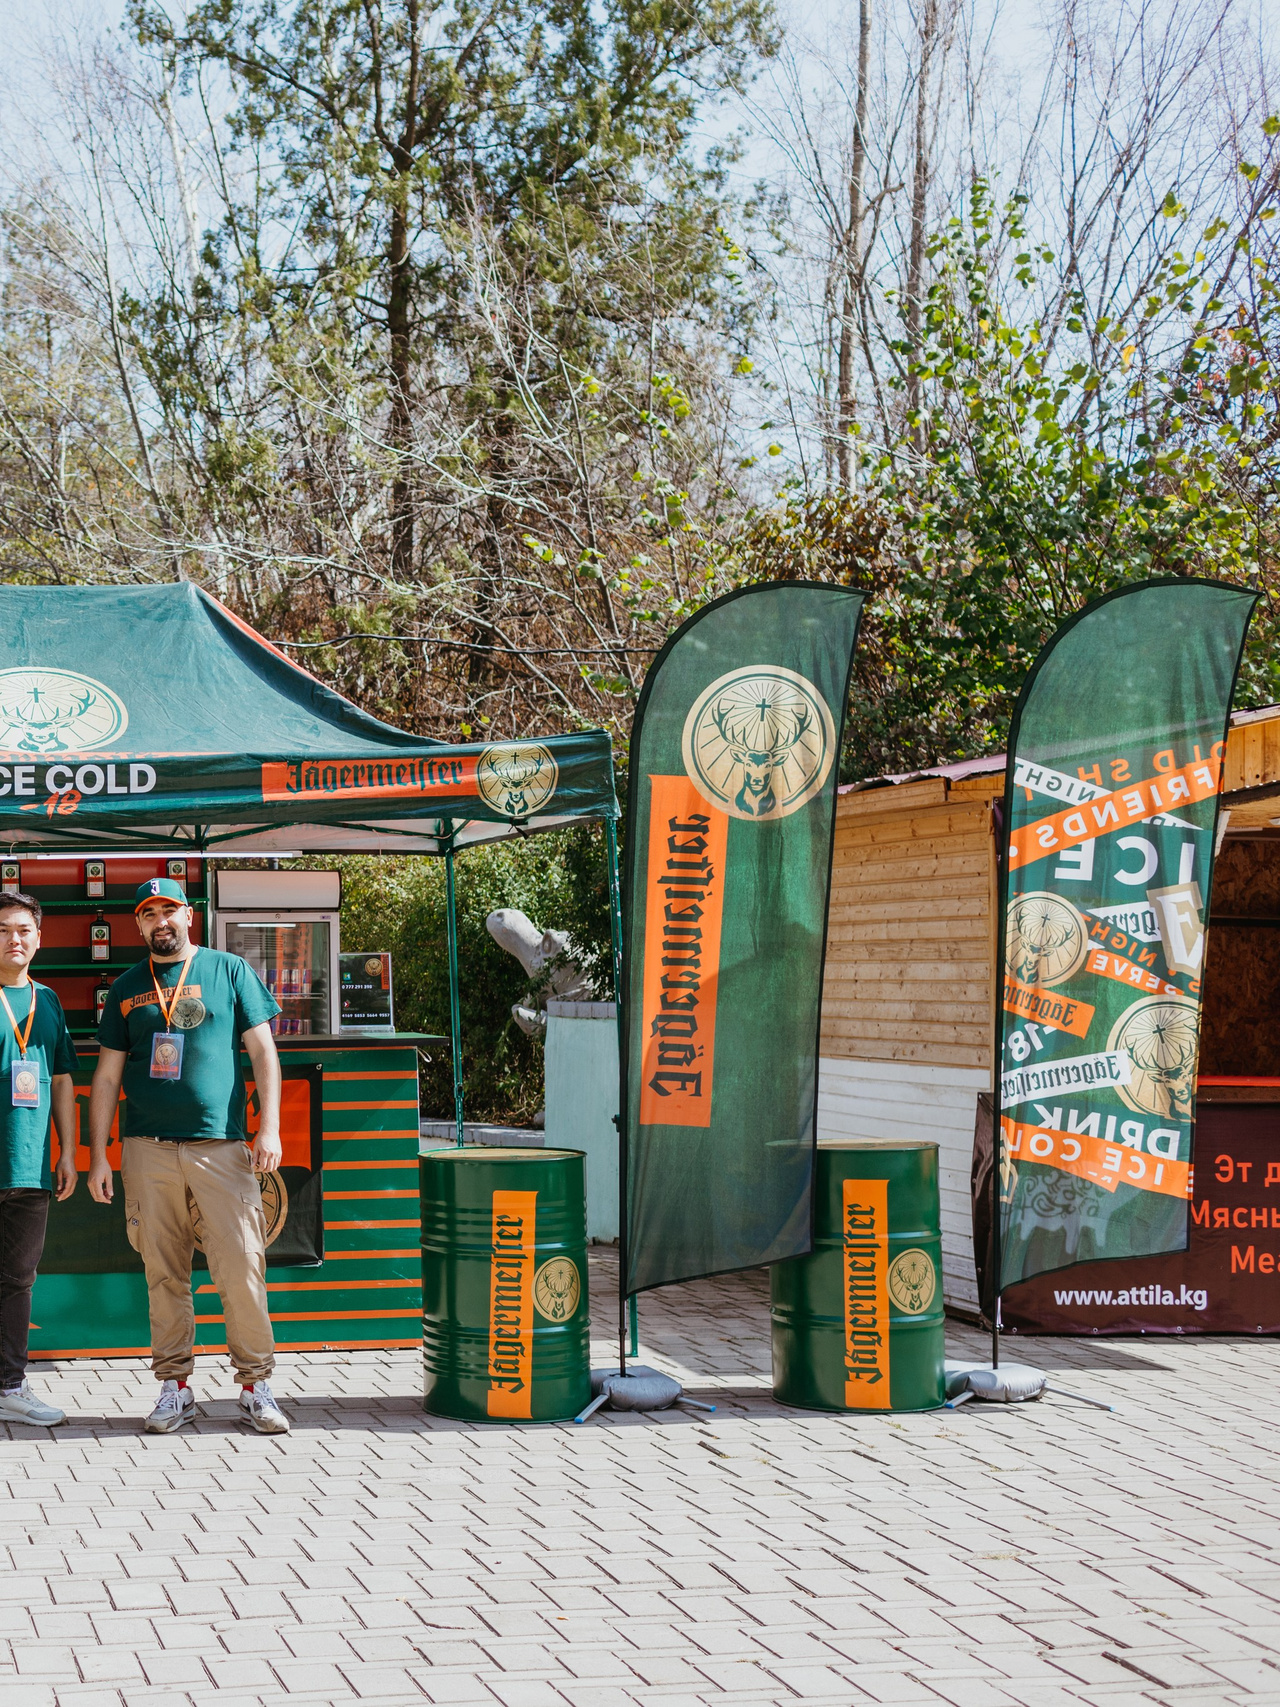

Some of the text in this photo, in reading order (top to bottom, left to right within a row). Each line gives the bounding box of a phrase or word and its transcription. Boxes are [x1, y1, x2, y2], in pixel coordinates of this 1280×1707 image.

[45, 763, 158, 796] COLD
[1214, 1154, 1252, 1183] Эт
[1053, 1284, 1208, 1311] www.attila.kg
